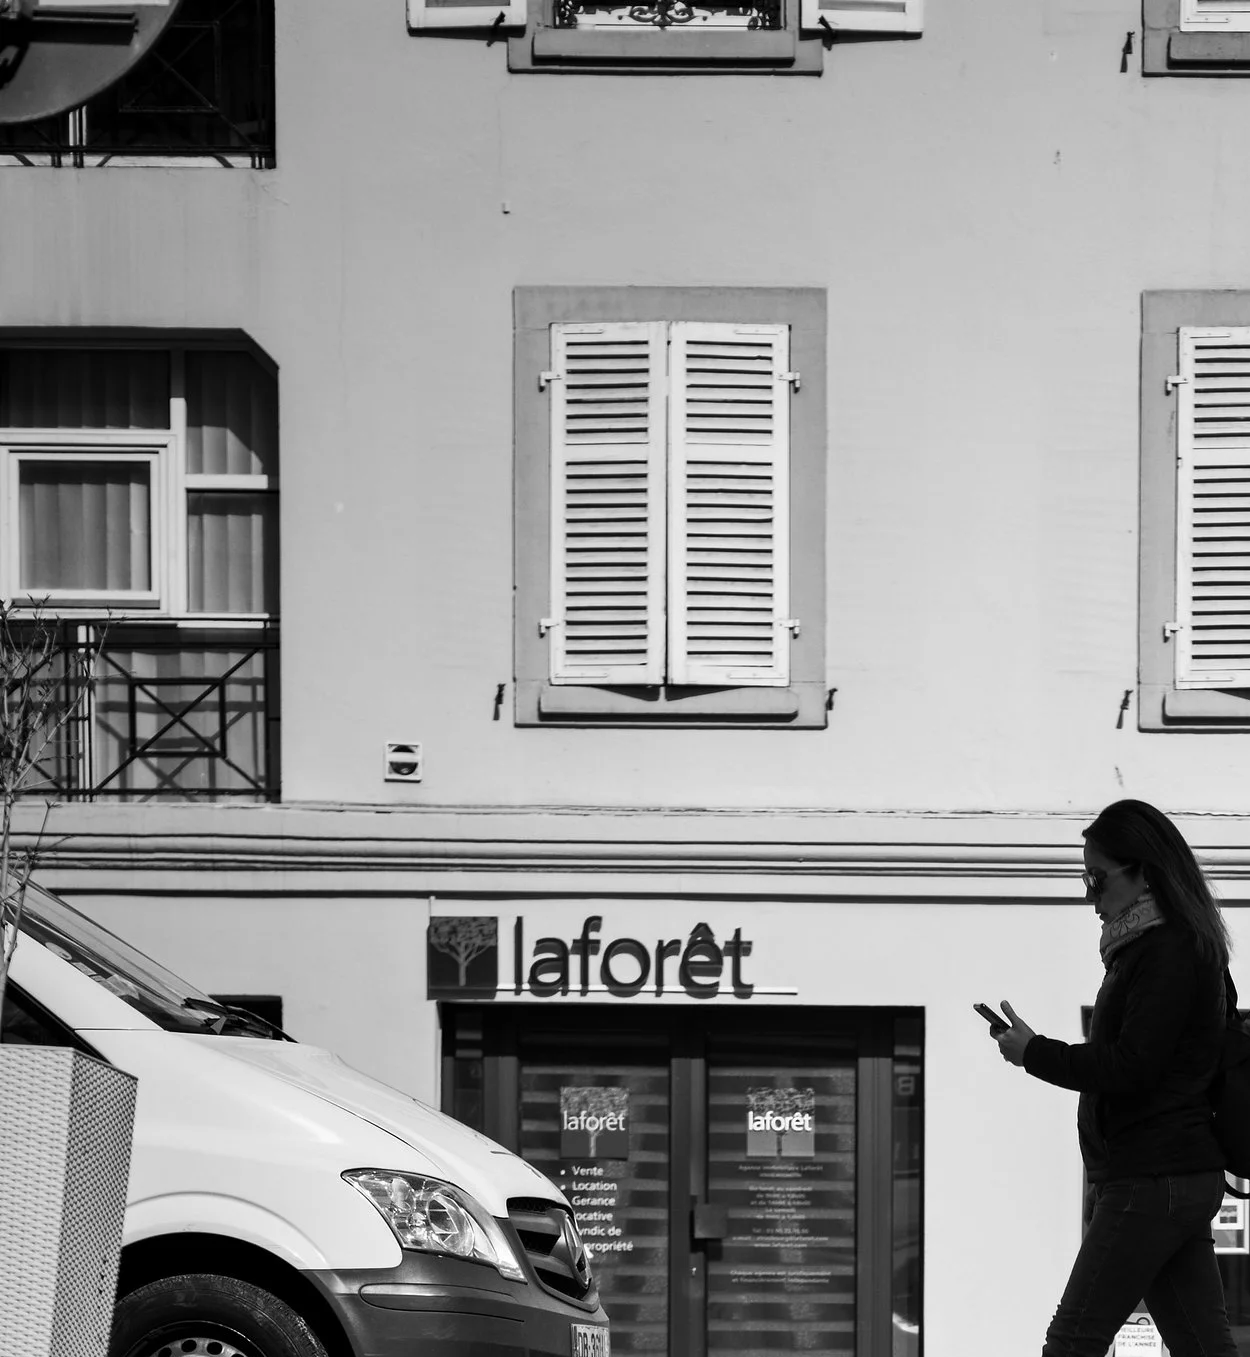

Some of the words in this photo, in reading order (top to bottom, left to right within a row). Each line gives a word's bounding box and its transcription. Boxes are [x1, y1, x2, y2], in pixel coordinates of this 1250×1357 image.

[514, 915, 754, 997] laforêt
[563, 1110, 626, 1132] laforêt
[747, 1110, 813, 1132] laforêt
[572, 1165, 604, 1176] Vente
[572, 1180, 618, 1191] Location
[575, 1210, 613, 1221] ocative
[578, 1225, 606, 1237] yndic
[608, 1225, 622, 1237] de
